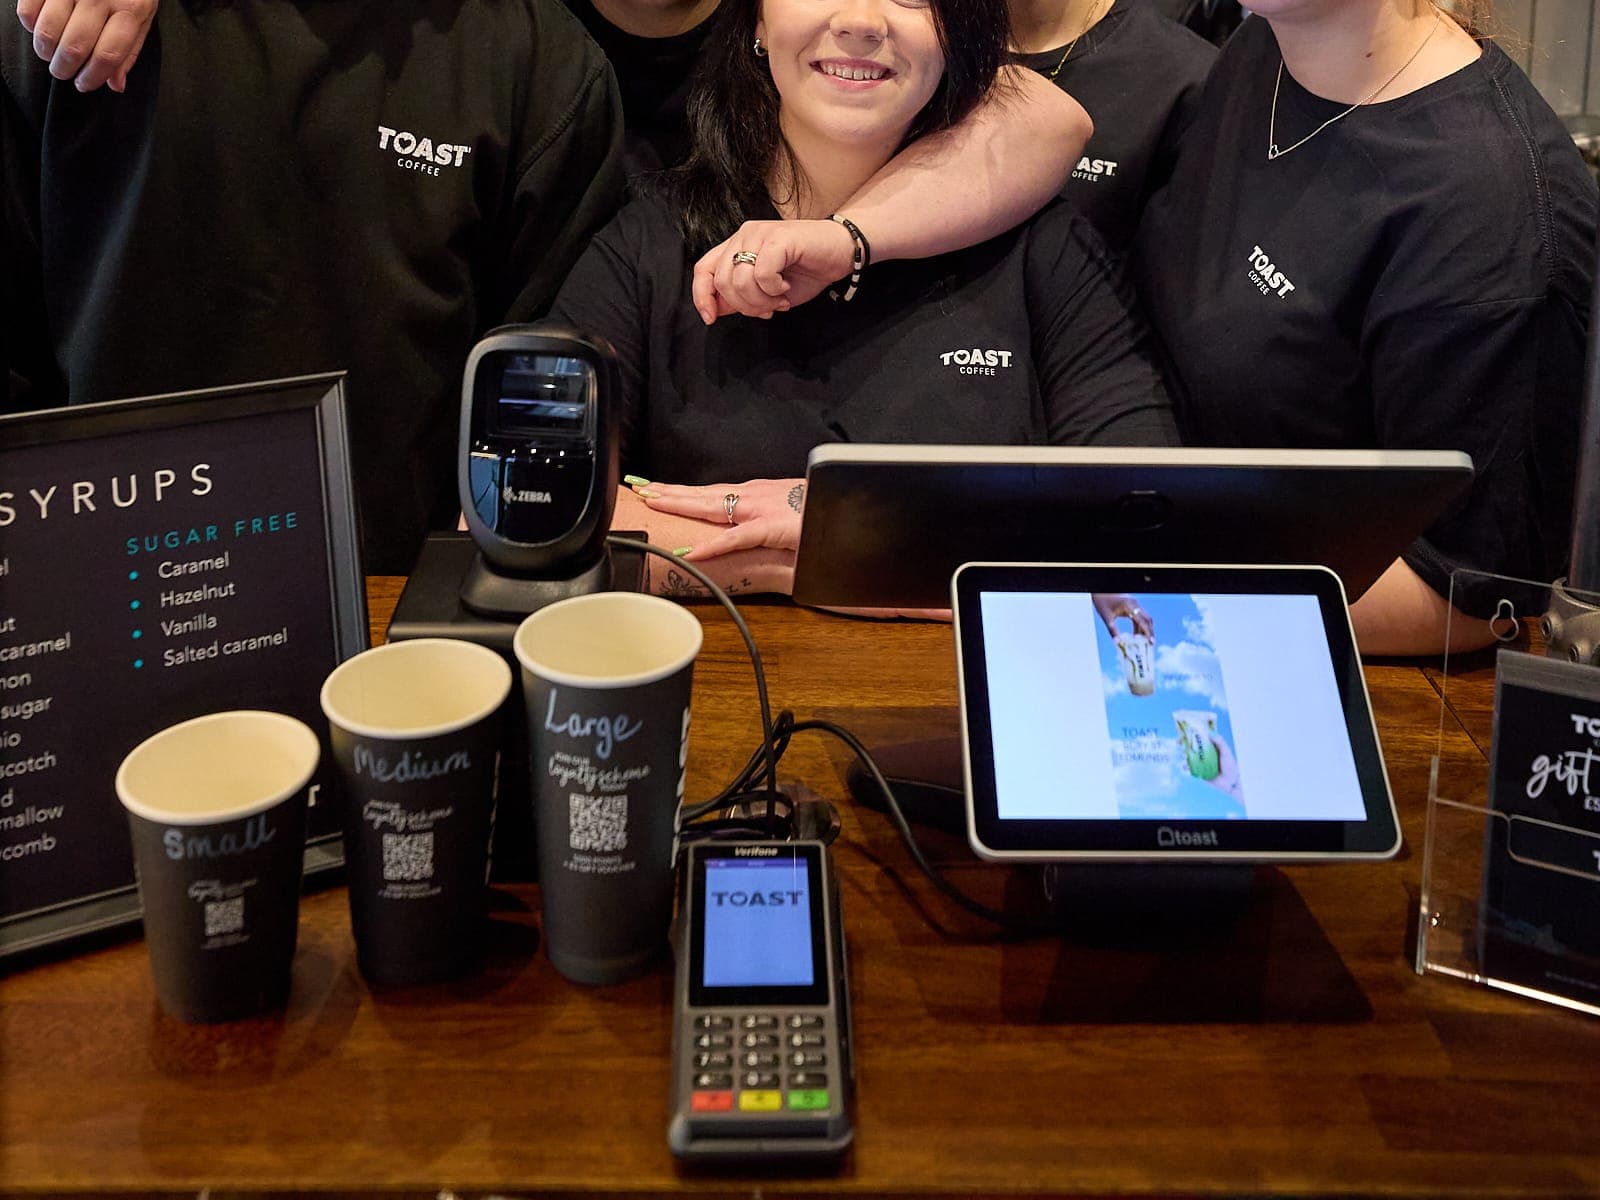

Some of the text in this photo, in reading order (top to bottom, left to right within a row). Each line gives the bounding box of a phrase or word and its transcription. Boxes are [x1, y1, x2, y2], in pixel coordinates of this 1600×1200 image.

[378, 125, 471, 167] TOAST
[397, 158, 440, 177] COFFEE
[1071, 170, 1098, 182] OFFEE
[1077, 156, 1117, 176] AST
[1248, 245, 1296, 298] TOAST
[1248, 270, 1270, 296] COFFEE
[960, 366, 995, 376] COFFEE
[0, 463, 213, 526] SYRUPS
[518, 490, 552, 503] ZEBRA
[126, 512, 298, 555] SUGAR FREE
[158, 552, 230, 579] Caramel
[160, 582, 236, 608] Hazelnut
[160, 613, 217, 637] Vanilla
[0, 631, 71, 661] caramel
[163, 627, 288, 667] Salted caramel
[1, 697, 53, 719] sugar
[545, 688, 643, 759] Large
[1122, 727, 1160, 739] TOAST
[353, 744, 471, 783] Medium
[1526, 748, 1600, 798] gift
[0, 805, 64, 831] mallow
[2, 832, 56, 861] comb
[163, 814, 277, 860] Small
[1174, 827, 1218, 847] toast
[735, 846, 778, 856] Verifone
[711, 890, 803, 907] TOAST
